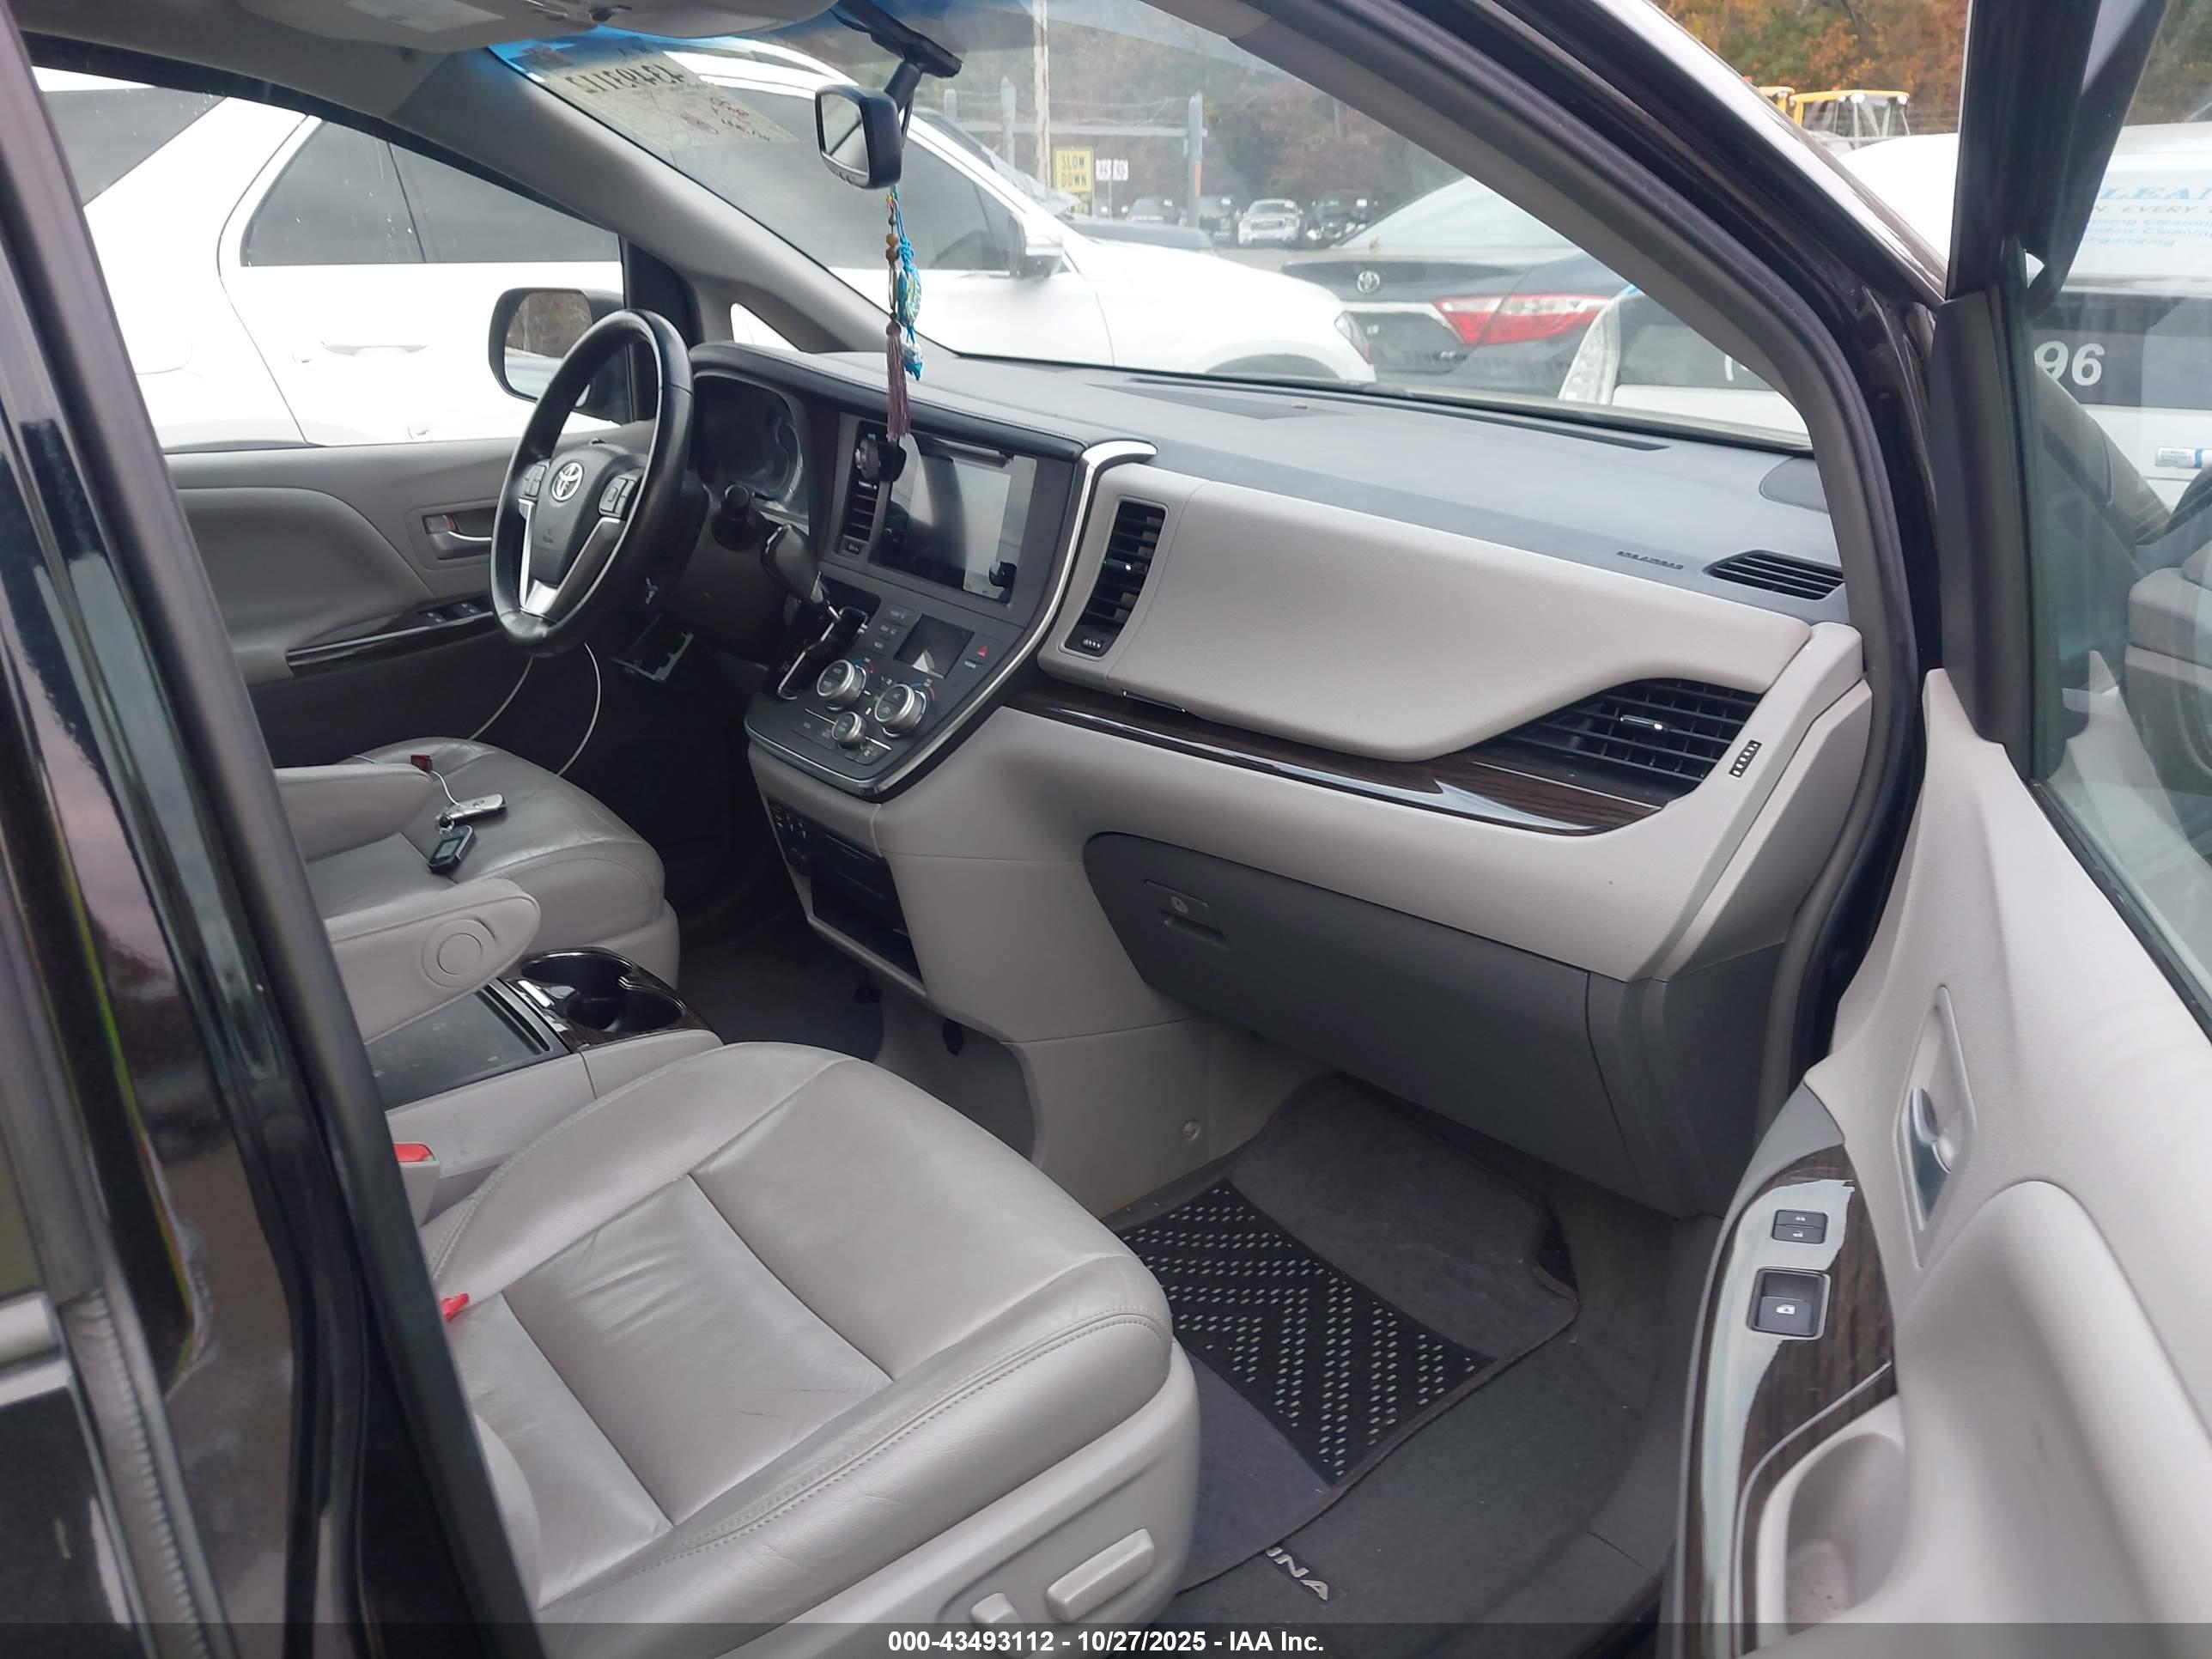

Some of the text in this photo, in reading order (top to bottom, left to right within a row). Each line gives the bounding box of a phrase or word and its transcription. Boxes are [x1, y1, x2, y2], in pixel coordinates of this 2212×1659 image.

[1060, 155, 1085, 170] SLOW
[1061, 173, 1087, 187] DOWN
[2034, 340, 2106, 386] 96
